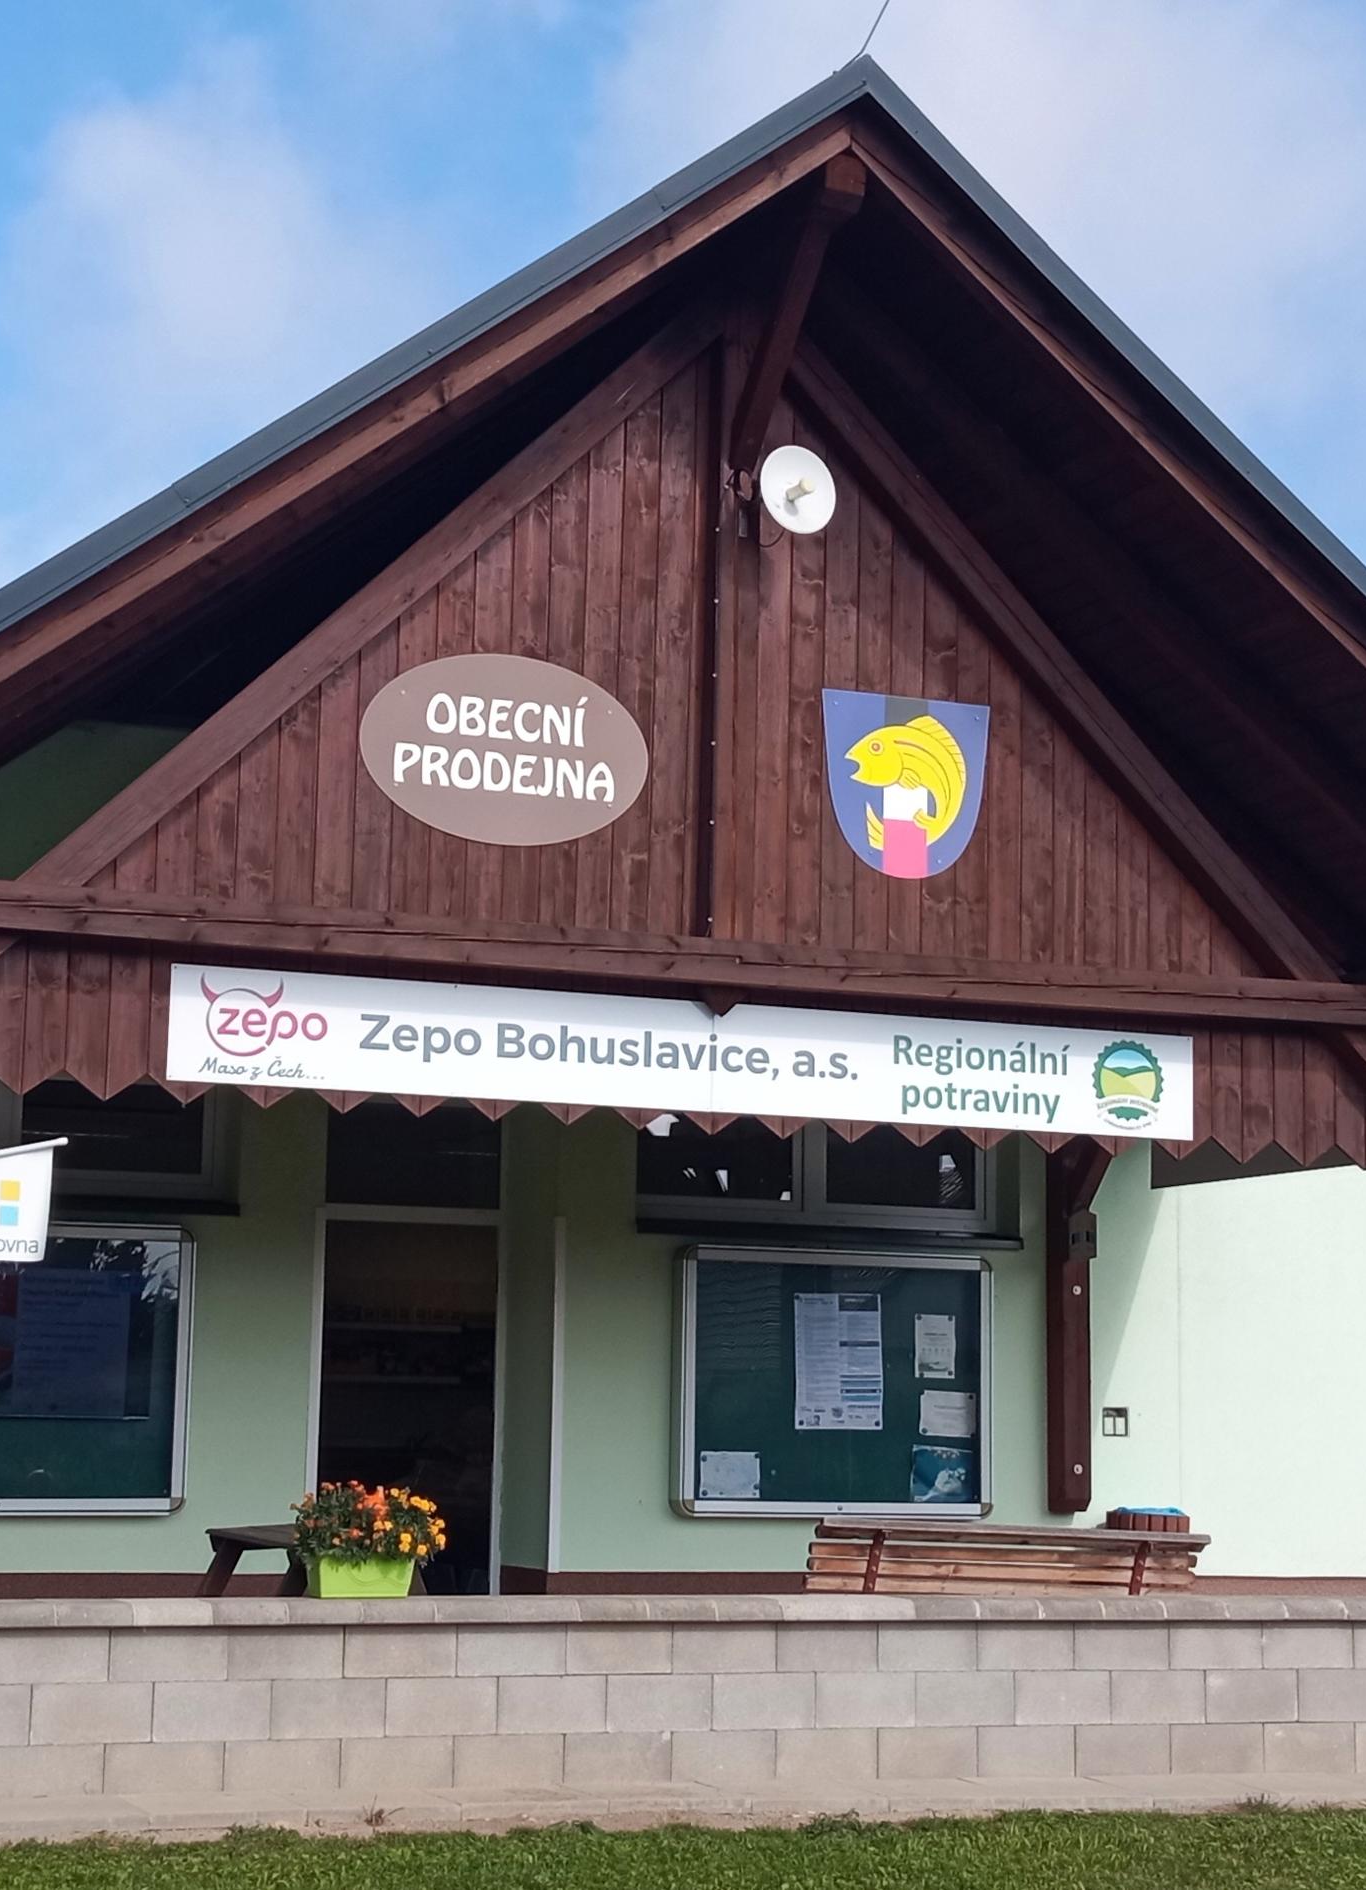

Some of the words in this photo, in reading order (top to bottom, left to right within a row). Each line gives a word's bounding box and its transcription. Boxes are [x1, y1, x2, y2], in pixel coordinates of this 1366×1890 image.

[426, 692, 588, 747] OBECNÍ
[392, 742, 615, 802] PRODEJNA
[217, 1008, 328, 1046] zepo
[359, 1014, 482, 1062] Zepo
[496, 1023, 780, 1080] Bohuslavice,
[792, 1050, 858, 1081] a.s.
[198, 1057, 247, 1075] Maso
[249, 1066, 263, 1081] z
[893, 1035, 1071, 1076] Regionální
[901, 1083, 1061, 1124] potraviny
